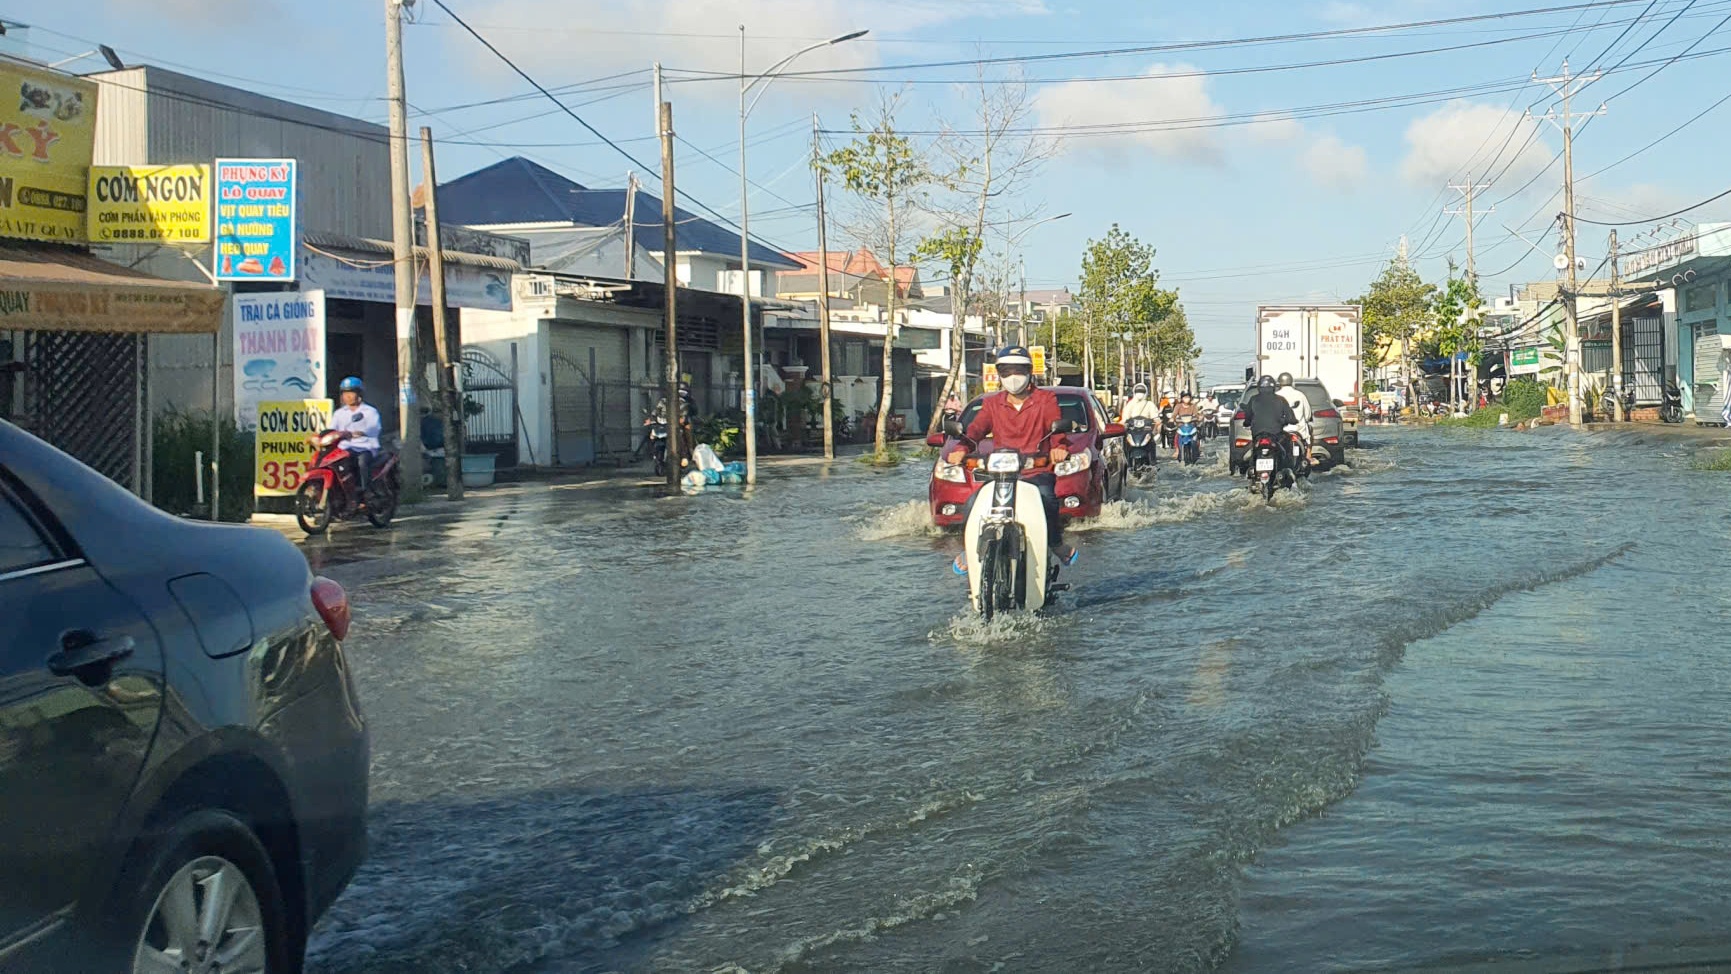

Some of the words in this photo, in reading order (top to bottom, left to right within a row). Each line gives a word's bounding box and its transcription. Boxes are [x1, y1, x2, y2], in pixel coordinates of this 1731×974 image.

[221, 166, 267, 183] PHỤNG
[96, 170, 139, 202] CƠM
[144, 175, 203, 202] NGON
[246, 188, 286, 199] QUAY
[239, 204, 264, 217] QUAY
[221, 243, 241, 255] HEO
[243, 243, 269, 255] QUAY
[240, 304, 264, 325] TRẠI
[266, 299, 281, 320] CÁ
[1273, 329, 1290, 339] 94H
[1266, 341, 1296, 351] 002.01
[260, 407, 288, 432] CƠM
[262, 441, 305, 456] PHỤNG
